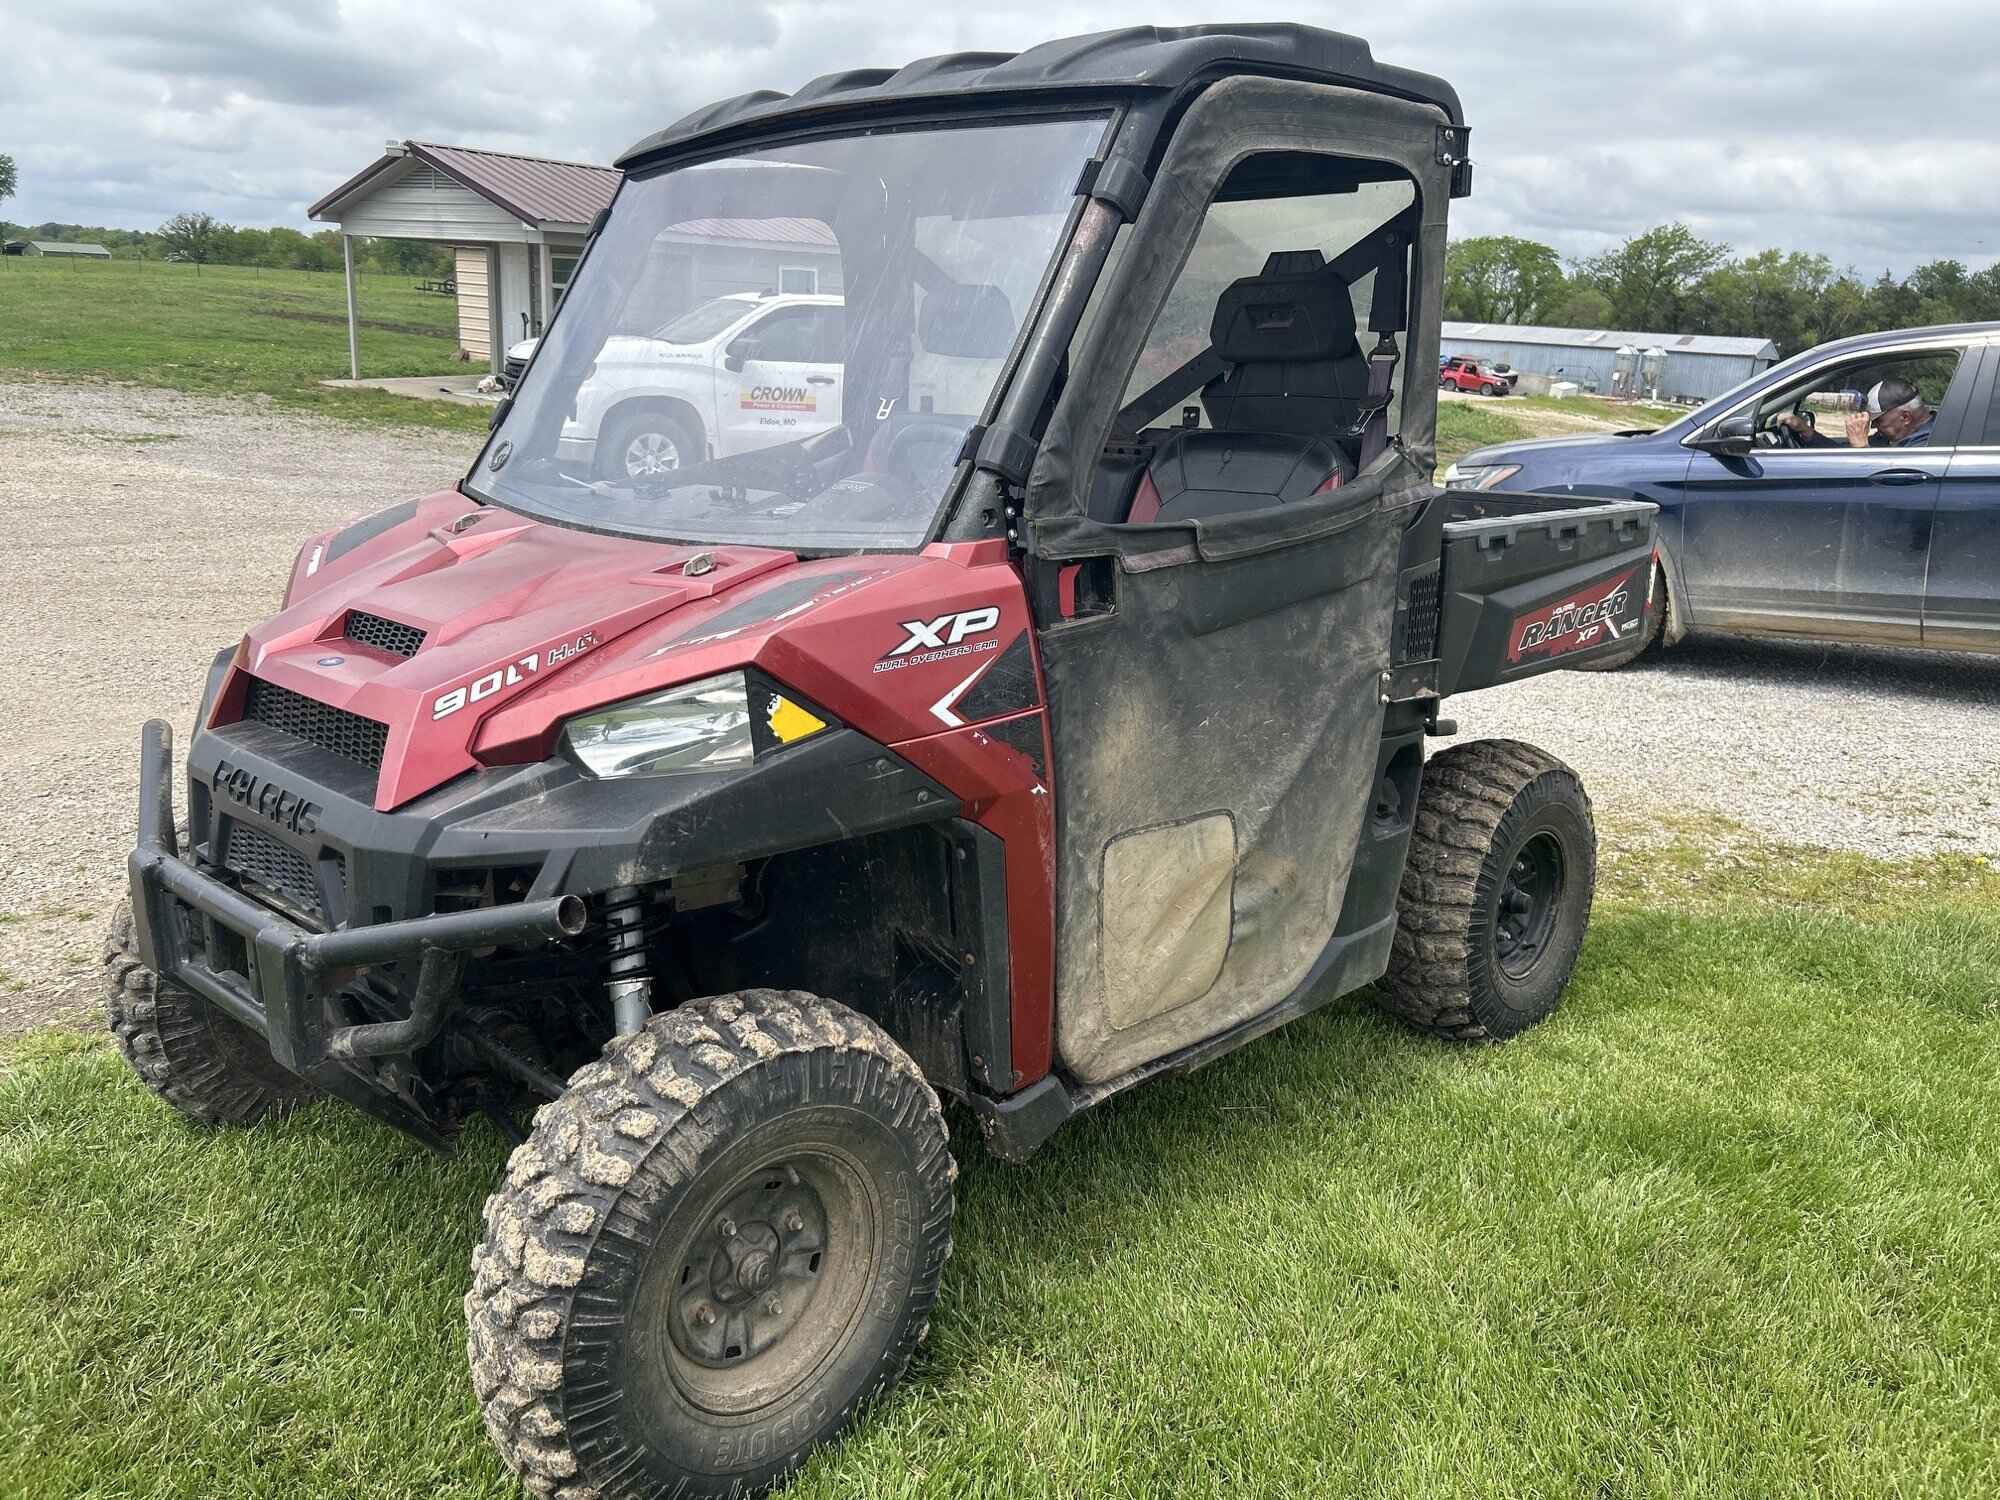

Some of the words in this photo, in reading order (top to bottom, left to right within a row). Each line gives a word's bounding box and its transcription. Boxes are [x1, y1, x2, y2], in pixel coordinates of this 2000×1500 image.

[750, 386, 807, 402] CROWN
[784, 416, 797, 426] MO
[882, 605, 1001, 658] XP
[1517, 590, 1628, 651] RANGER
[1575, 625, 1599, 644] XP
[873, 658, 908, 673] DUAL
[910, 644, 973, 666] OVERHEAD
[973, 639, 999, 653] CAM
[212, 759, 325, 836] POLARIS
